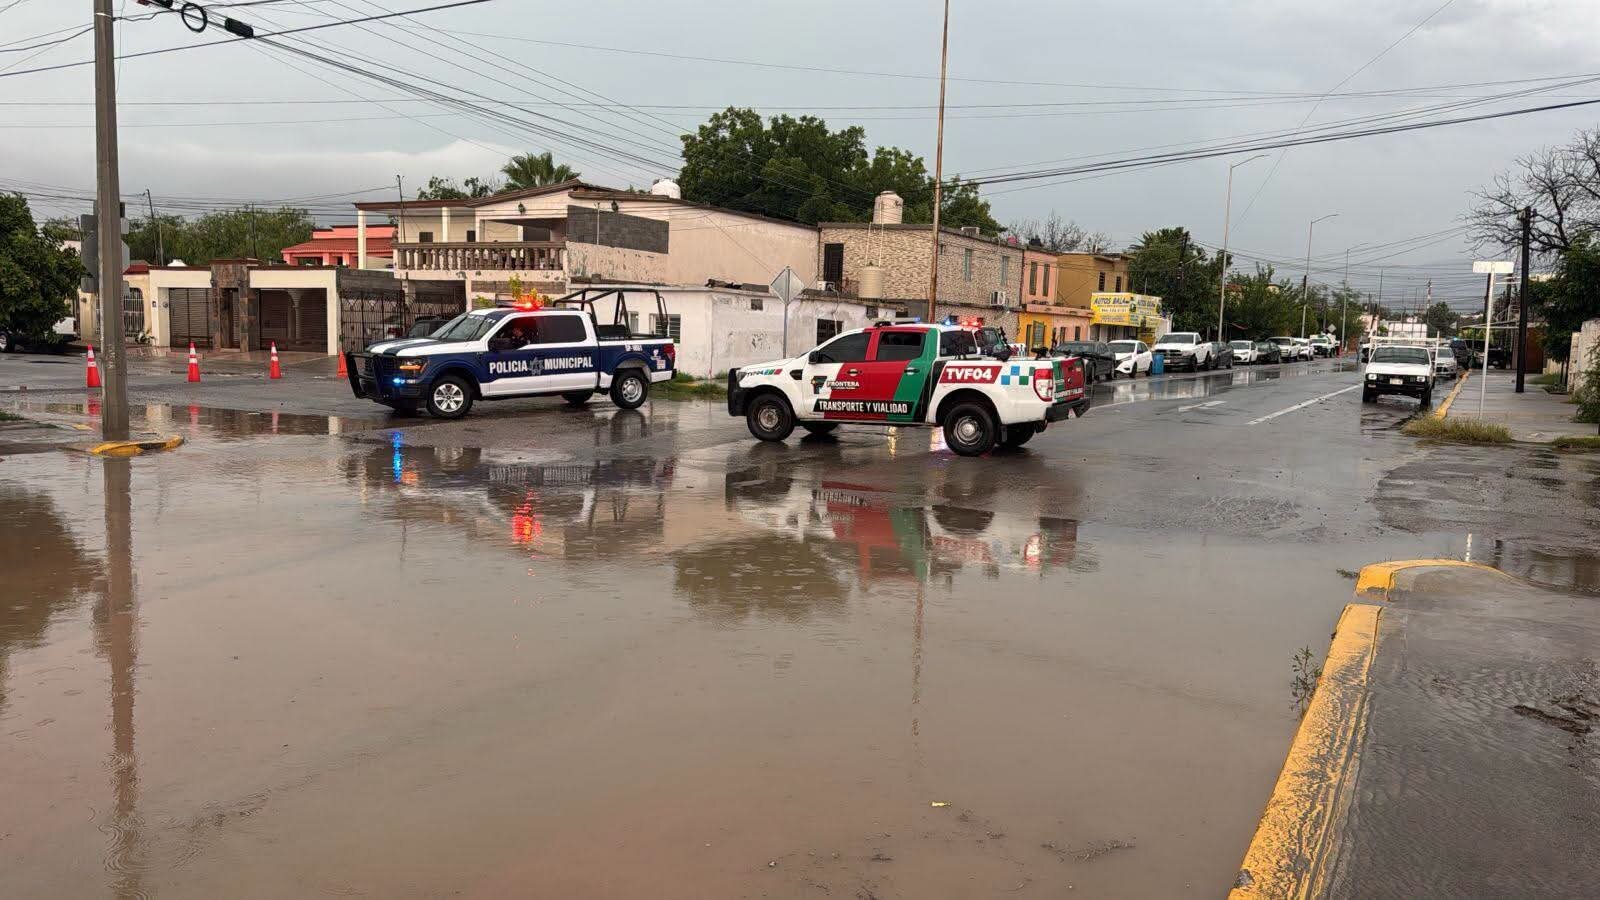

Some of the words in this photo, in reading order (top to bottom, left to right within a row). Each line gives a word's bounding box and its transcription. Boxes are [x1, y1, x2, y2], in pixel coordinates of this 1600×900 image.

[489, 360, 528, 374] POLICIA
[544, 356, 594, 370] MUNICIPAL
[946, 368, 993, 380] TVF04
[818, 401, 864, 412] TRANSPORTE
[866, 402, 871, 412] Y
[872, 403, 908, 413] VIALIDAD
